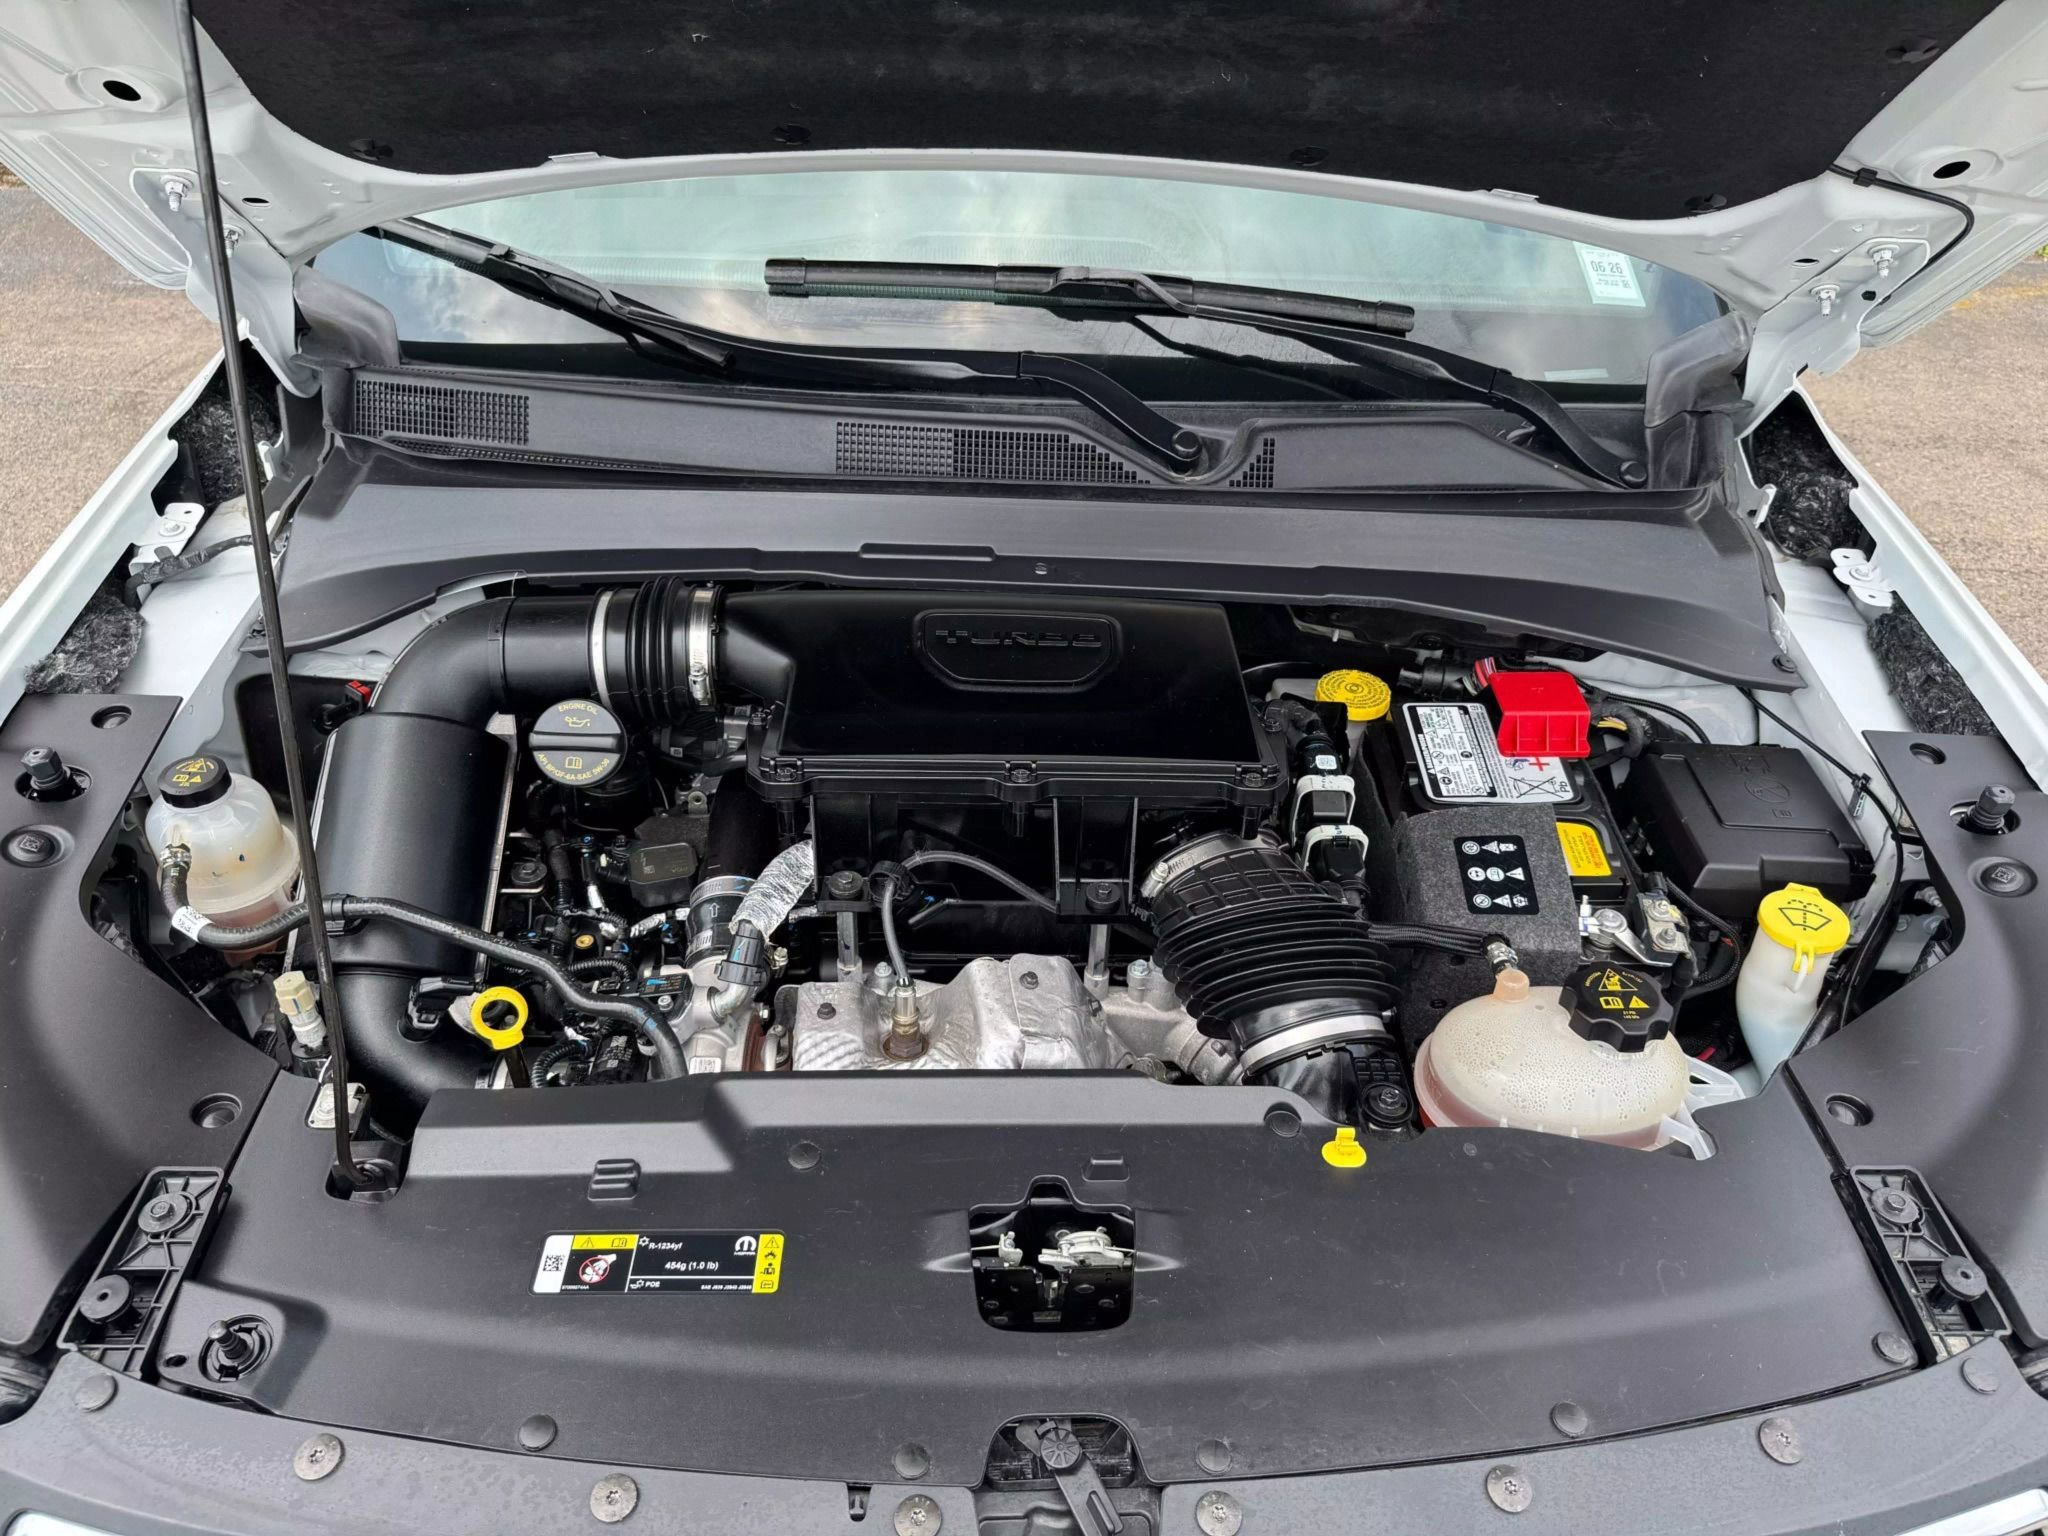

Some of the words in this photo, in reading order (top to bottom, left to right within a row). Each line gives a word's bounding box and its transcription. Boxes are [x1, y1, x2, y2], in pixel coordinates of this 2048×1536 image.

[935, 630, 1102, 648] TURBO
[558, 702, 587, 713] ENGINE
[587, 705, 598, 715] OIL
[1559, 781, 1571, 793] Pb
[648, 1242, 683, 1251] R-1234yf
[664, 1261, 687, 1271] 454g
[688, 1261, 705, 1271] (1.0
[706, 1261, 719, 1271] lb)
